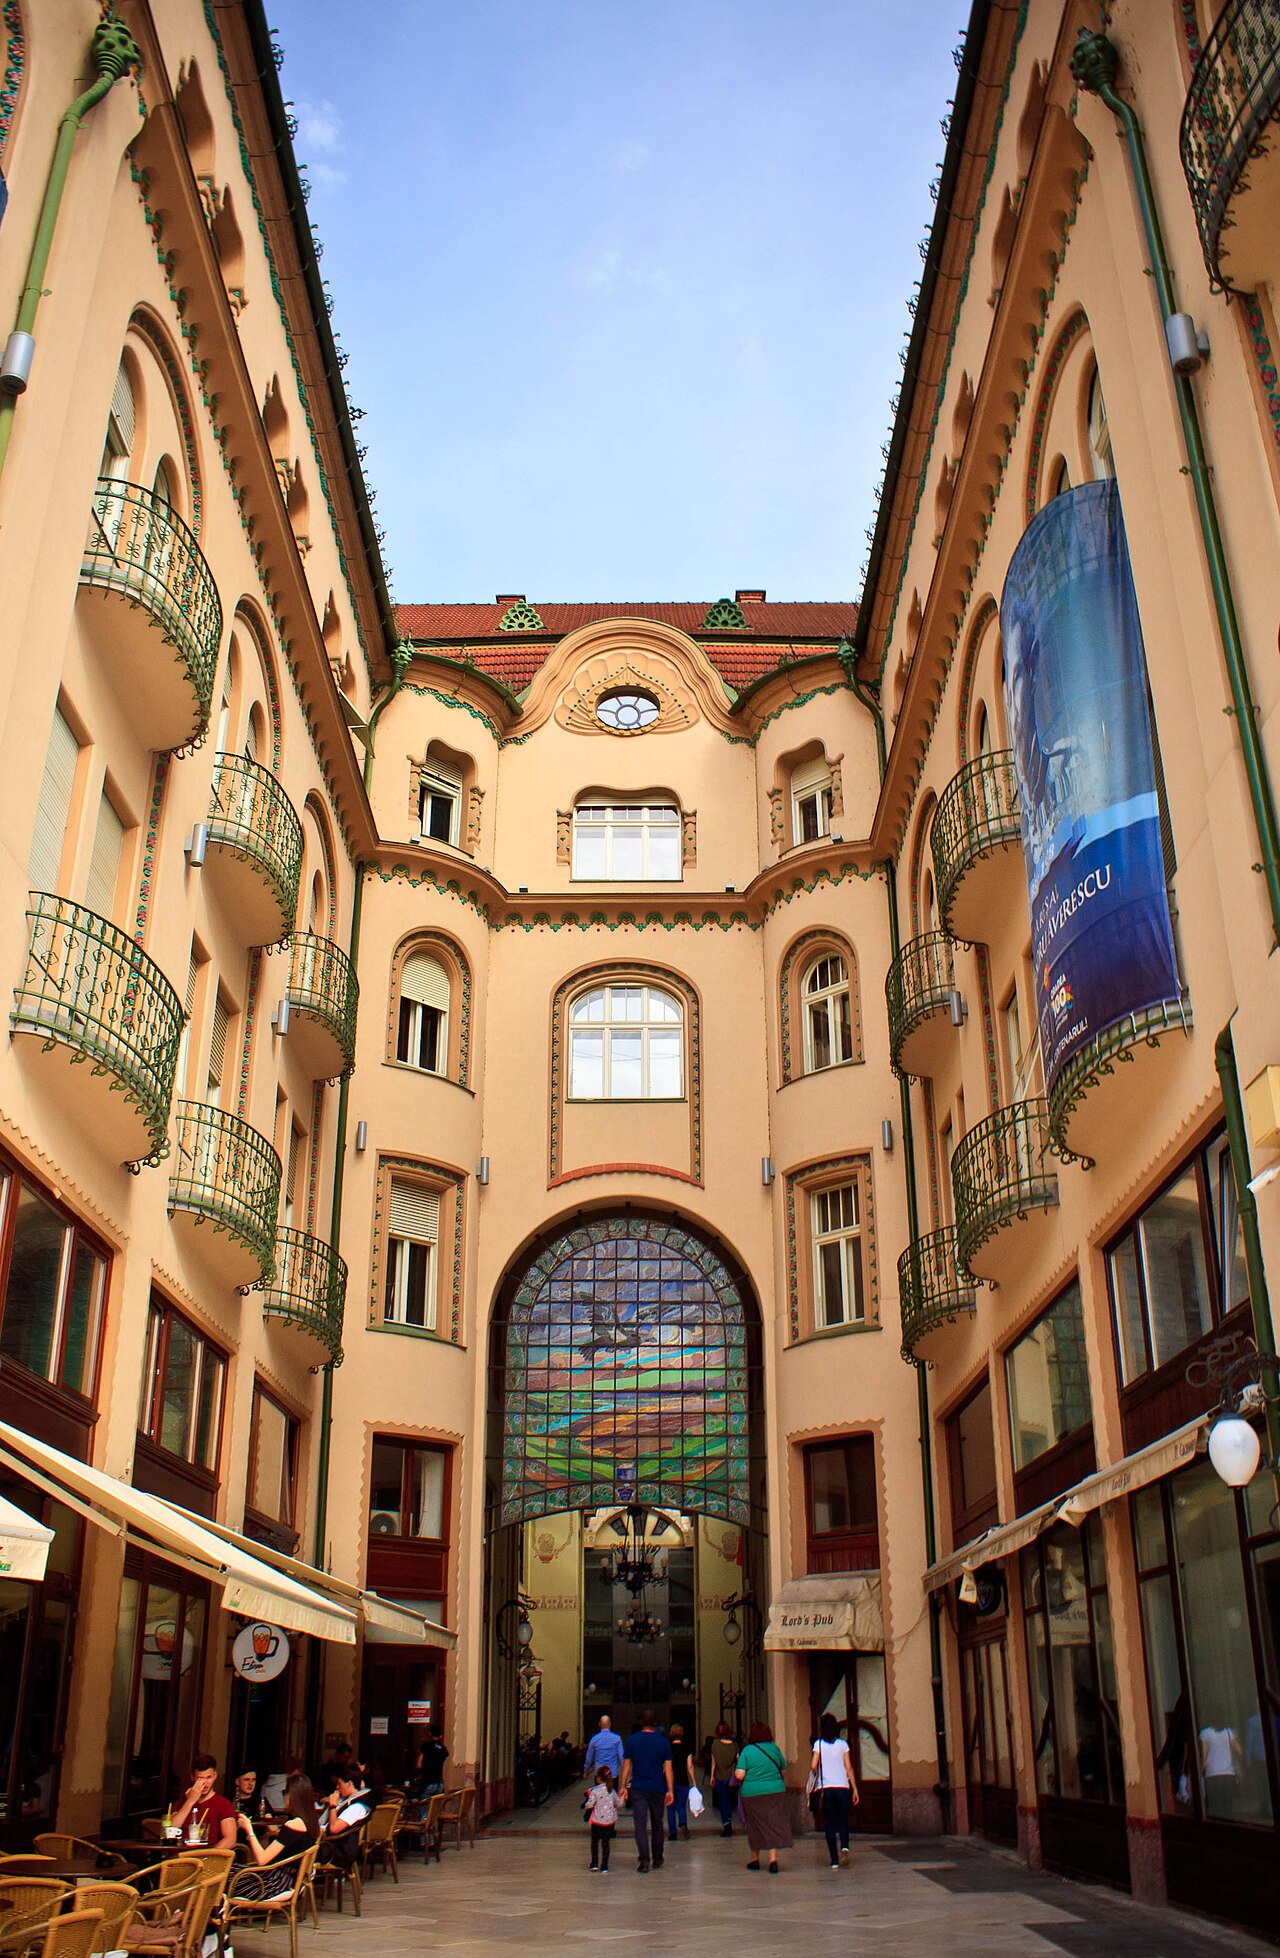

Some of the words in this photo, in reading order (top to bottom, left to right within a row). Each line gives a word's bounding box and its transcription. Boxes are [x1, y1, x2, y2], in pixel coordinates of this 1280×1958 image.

[1048, 864, 1111, 944] AVERESCU
[781, 1614, 810, 1626] Lord's
[813, 1614, 833, 1627] Pub
